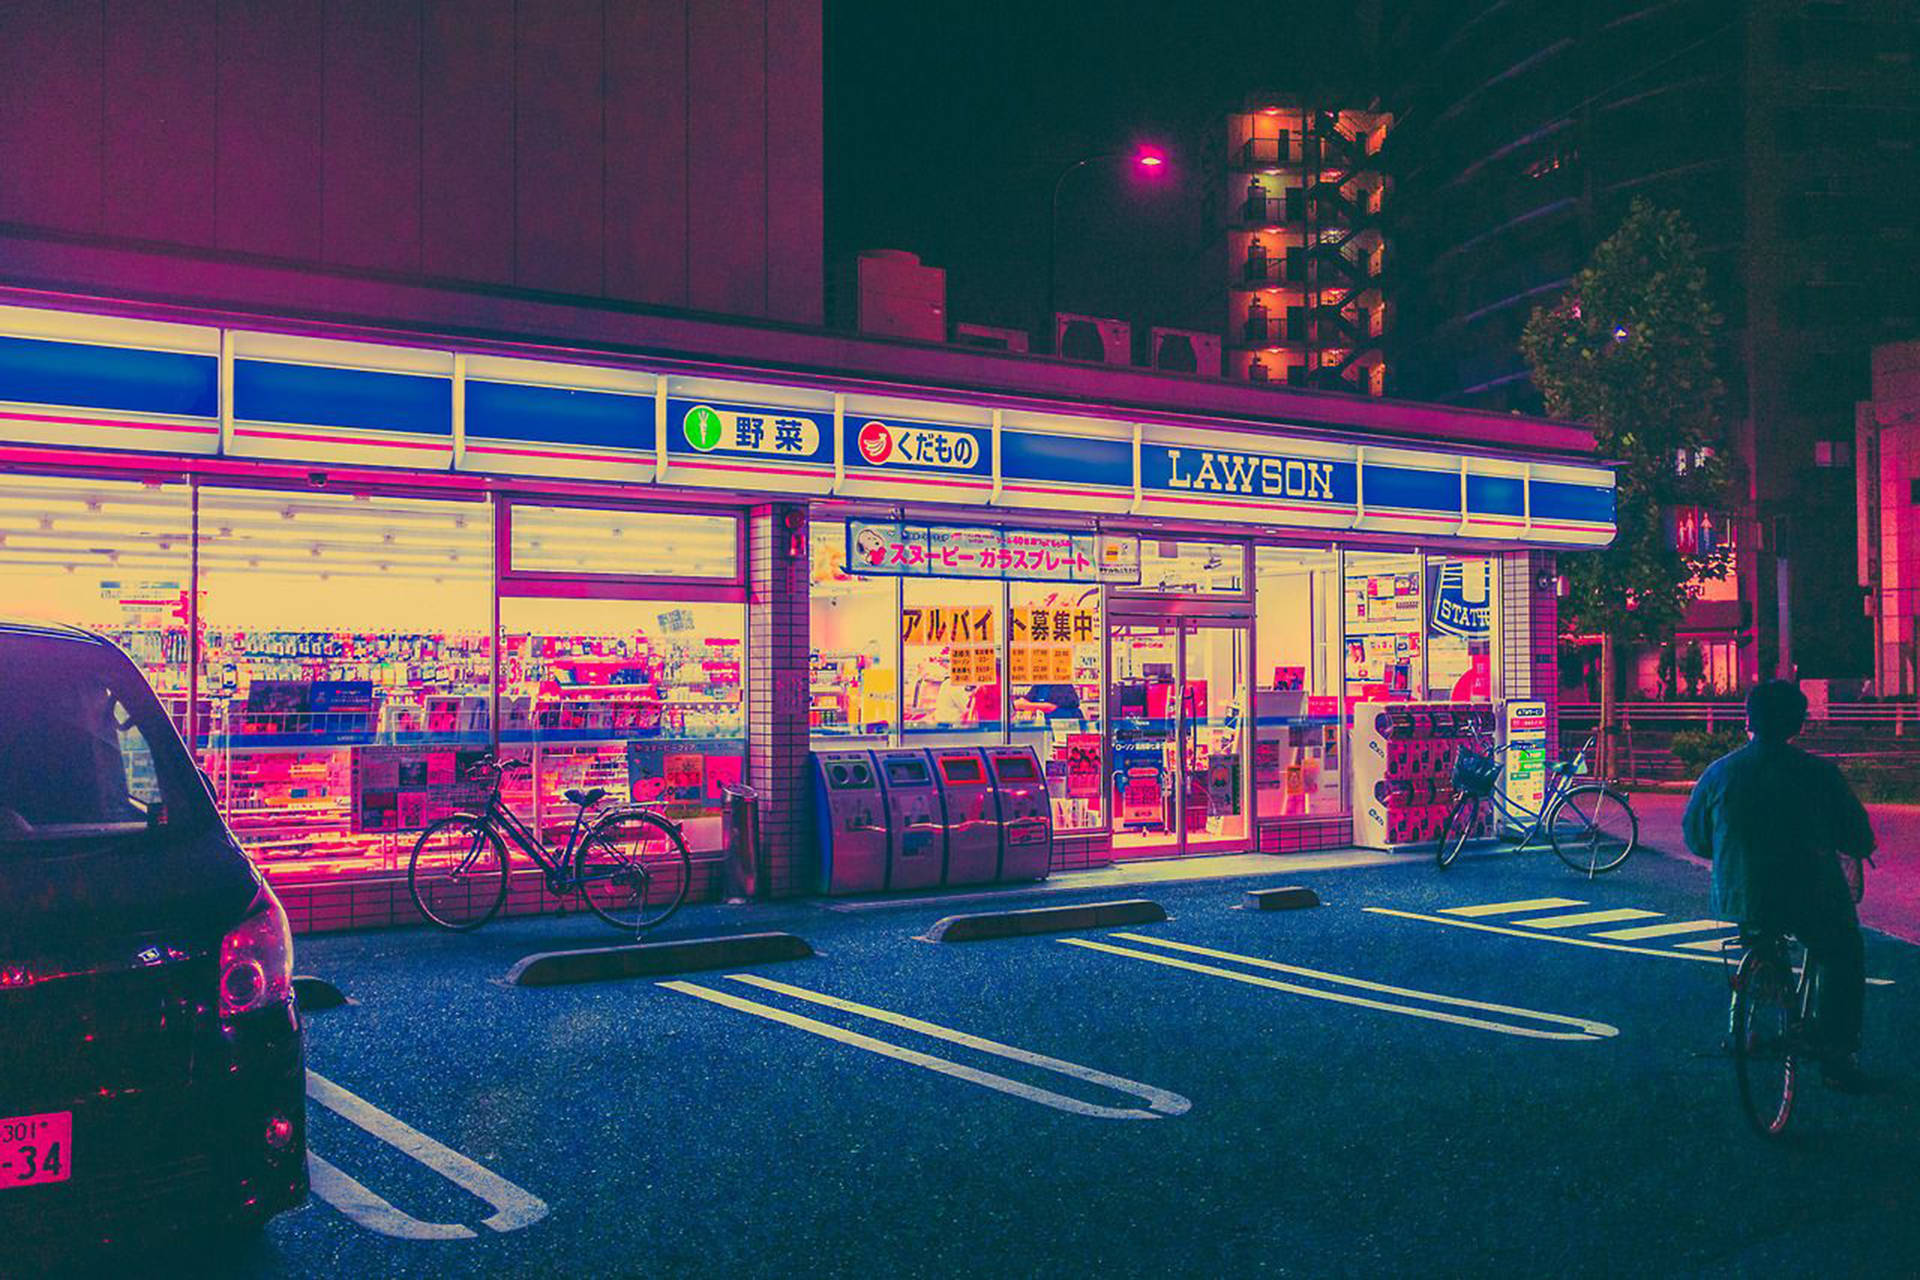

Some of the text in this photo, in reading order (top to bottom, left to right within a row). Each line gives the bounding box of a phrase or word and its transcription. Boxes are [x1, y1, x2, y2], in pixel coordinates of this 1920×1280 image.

[735, 416, 803, 451] 野菜
[897, 431, 973, 464] くだもの
[1168, 449, 1334, 499] LAWSON
[889, 543, 1091, 573] スヌーピー ガラスプレート
[2, 1121, 37, 1144] 301
